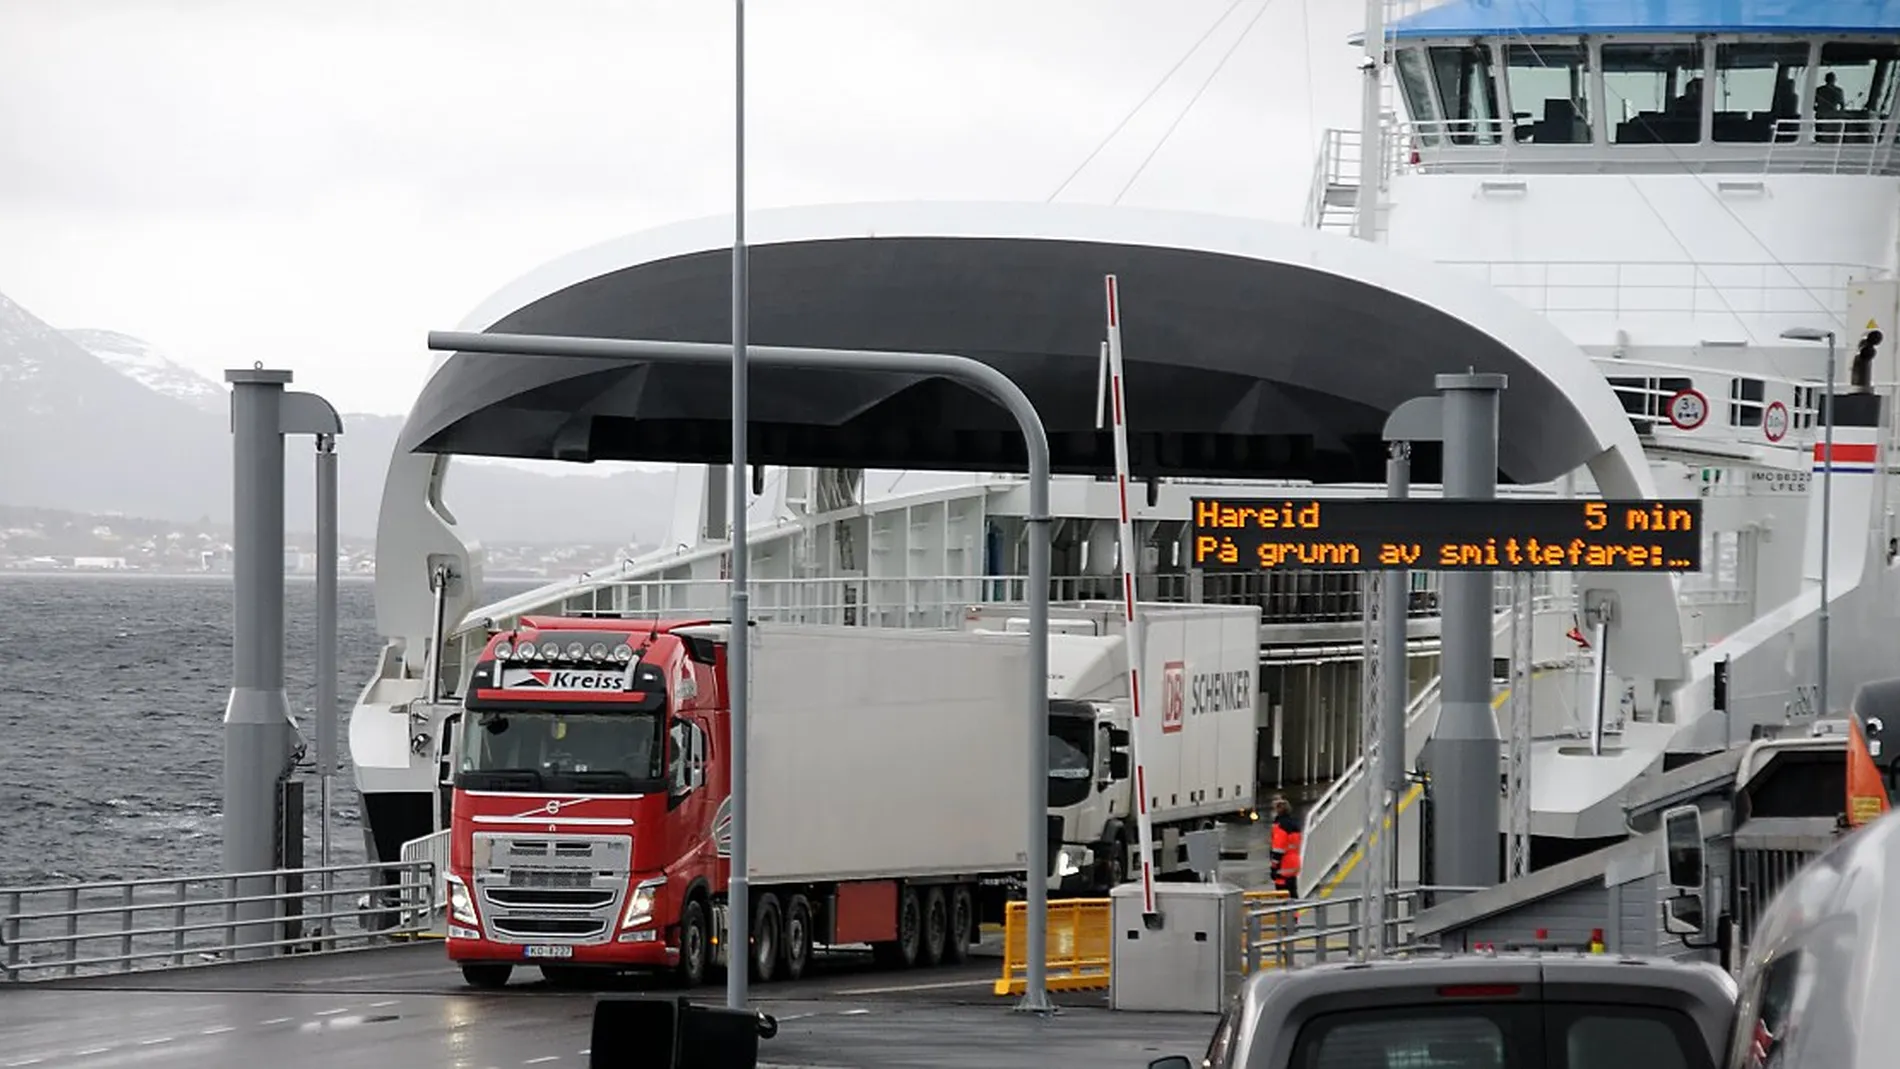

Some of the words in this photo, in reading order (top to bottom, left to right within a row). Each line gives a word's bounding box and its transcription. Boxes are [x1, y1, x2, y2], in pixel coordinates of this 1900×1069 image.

[1196, 501, 1320, 529] Hareid
[1585, 502, 1608, 531] 5
[1626, 503, 1692, 531] min
[1196, 536, 1238, 564] På
[1257, 543, 1360, 567] grunn
[1379, 543, 1421, 565] av
[553, 672, 623, 689] Kreiss
[1164, 671, 1183, 723] DB
[1191, 669, 1251, 716] SCHENKER
